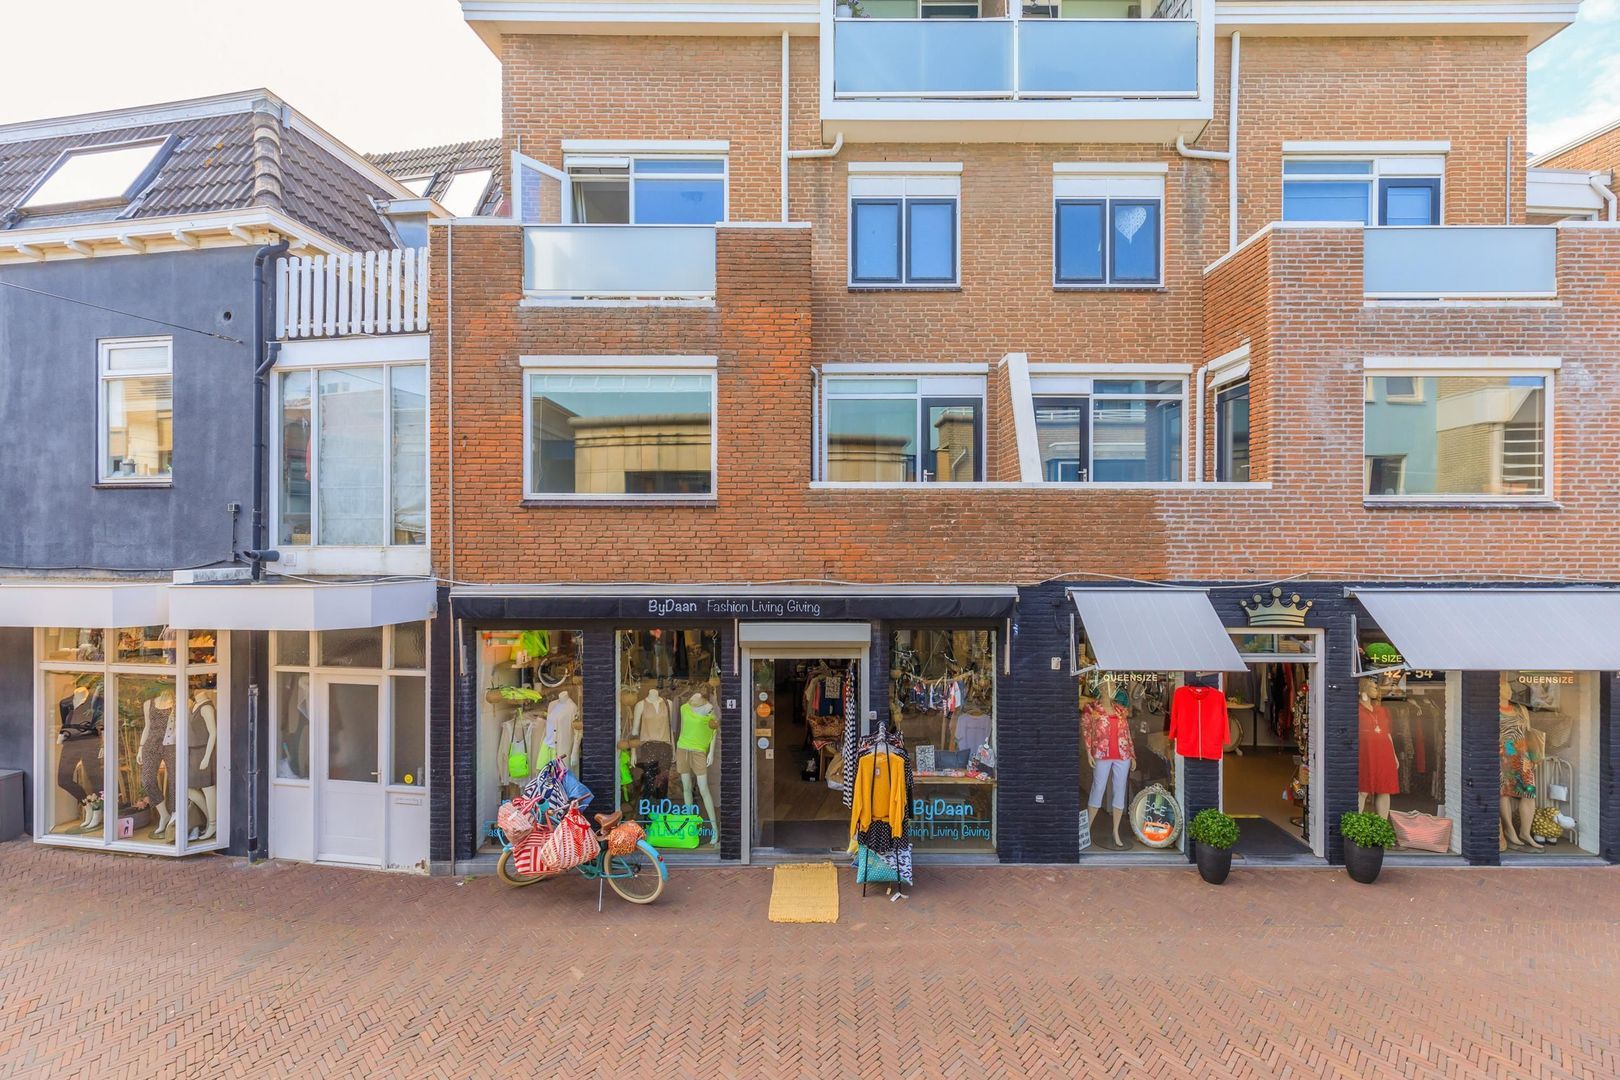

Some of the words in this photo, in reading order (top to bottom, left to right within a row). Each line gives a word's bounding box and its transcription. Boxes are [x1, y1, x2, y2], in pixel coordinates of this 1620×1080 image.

[648, 599, 697, 616] ByDaan
[707, 600, 749, 612] Fashion
[751, 600, 784, 616] Living
[787, 600, 821, 616] Giving
[1381, 654, 1402, 663] SIZE
[1103, 674, 1158, 682] QUEENSIZE
[1384, 669, 1401, 678] 42
[1415, 669, 1433, 679] 54
[1518, 676, 1574, 684] QUEENSIZE
[912, 799, 974, 820] ByDaan
[908, 825, 929, 837] hion
[931, 825, 959, 840] Living
[961, 825, 990, 840] Giving
